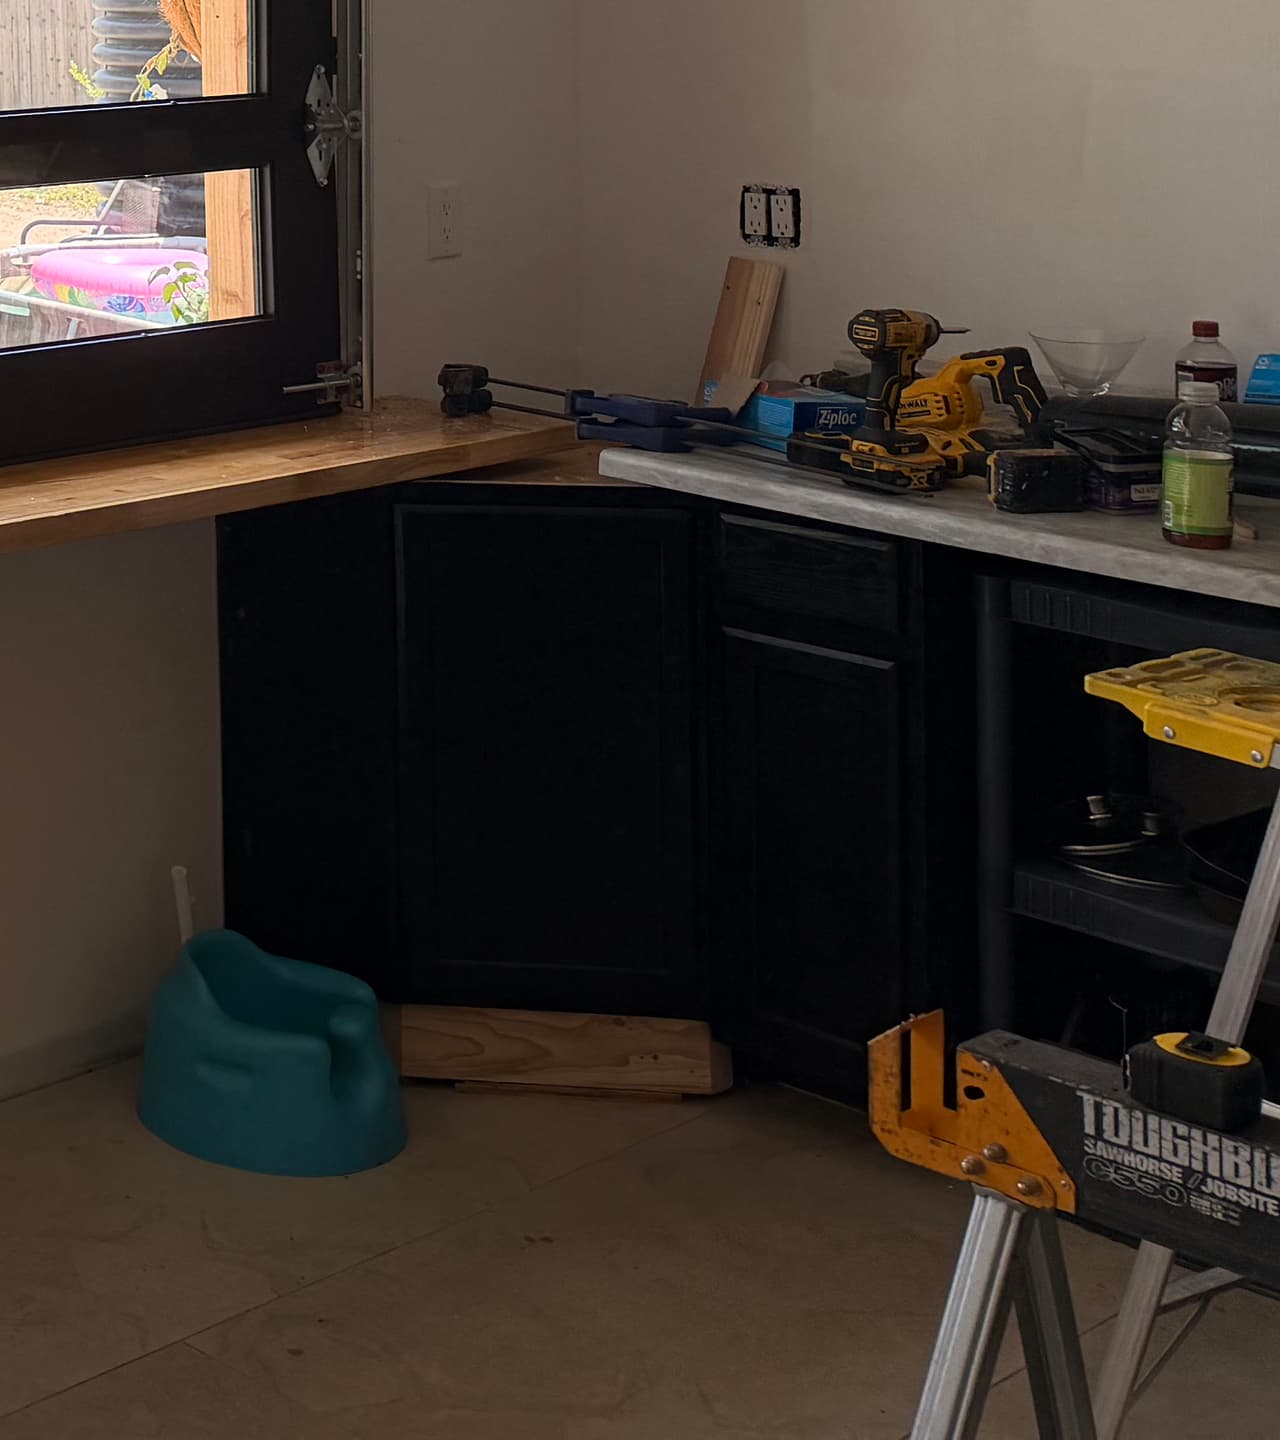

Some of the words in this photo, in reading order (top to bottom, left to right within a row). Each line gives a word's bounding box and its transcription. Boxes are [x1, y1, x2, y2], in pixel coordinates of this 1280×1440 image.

[818, 409, 857, 430] Ziploc
[1083, 1137, 1184, 1184] SAWHORSE
[1200, 1178, 1280, 1216] JOBSITE
